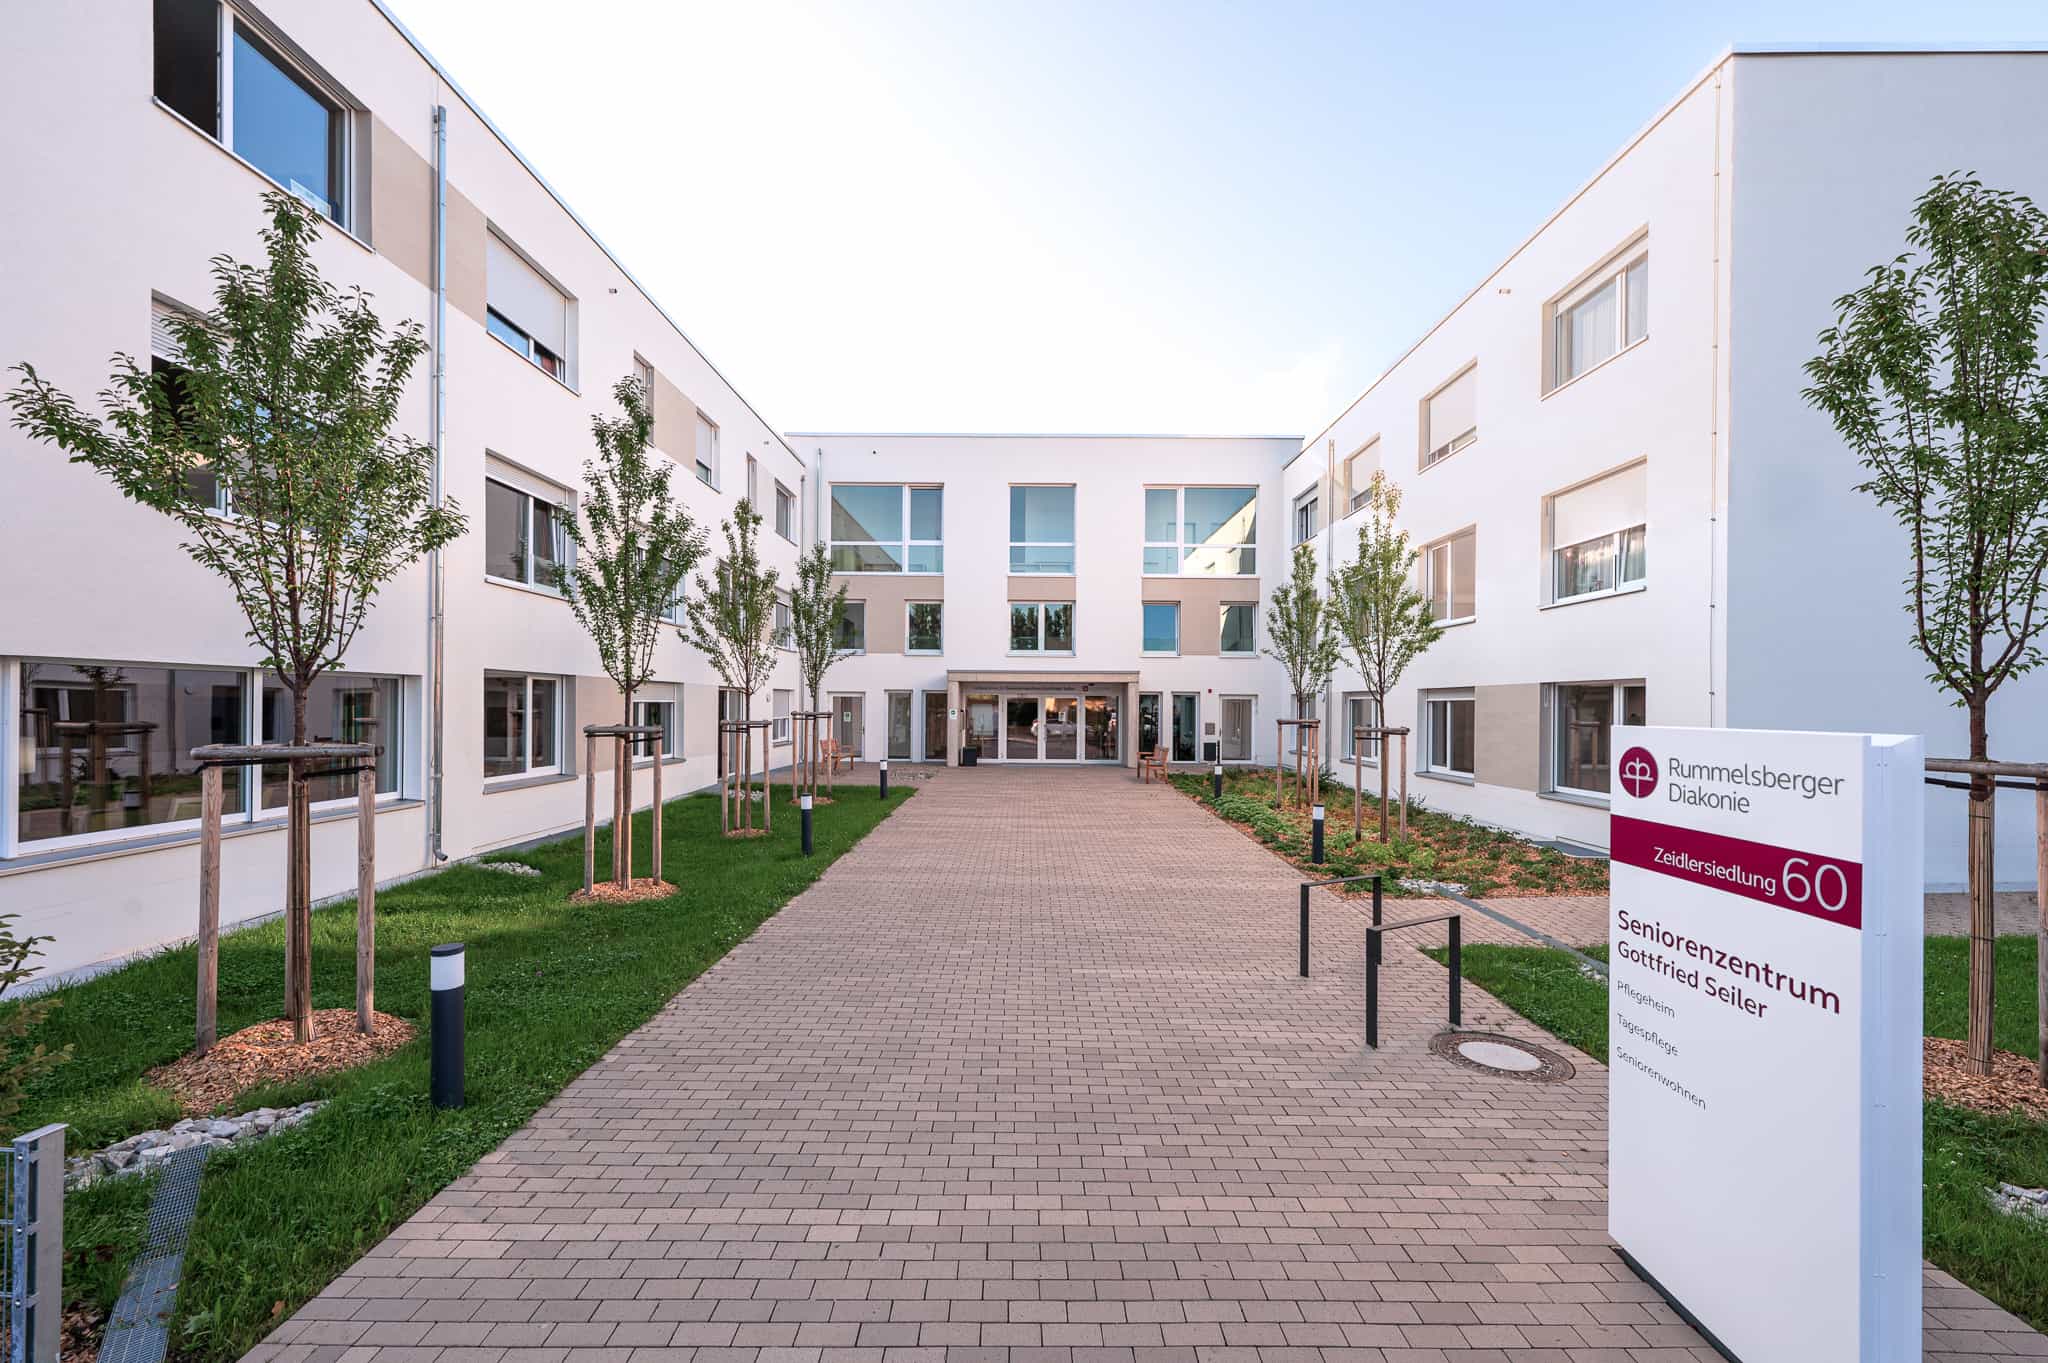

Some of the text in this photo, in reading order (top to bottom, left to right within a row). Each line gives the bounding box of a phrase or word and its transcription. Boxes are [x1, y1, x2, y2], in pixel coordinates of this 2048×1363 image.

[1669, 757, 1845, 799] Rummelsberger
[1669, 783, 1751, 813] Diakonie
[1653, 846, 1848, 911] Zeidlersiedlung 60
[1618, 910, 1840, 1014] Seniorenzentrum
[1618, 941, 1767, 1018] Gottfried Seiler
[1617, 980, 1675, 1018] Pflegeheim
[1617, 1013, 1679, 1057] Tagespflege
[1616, 1046, 1706, 1110] Seniorenwohnen
